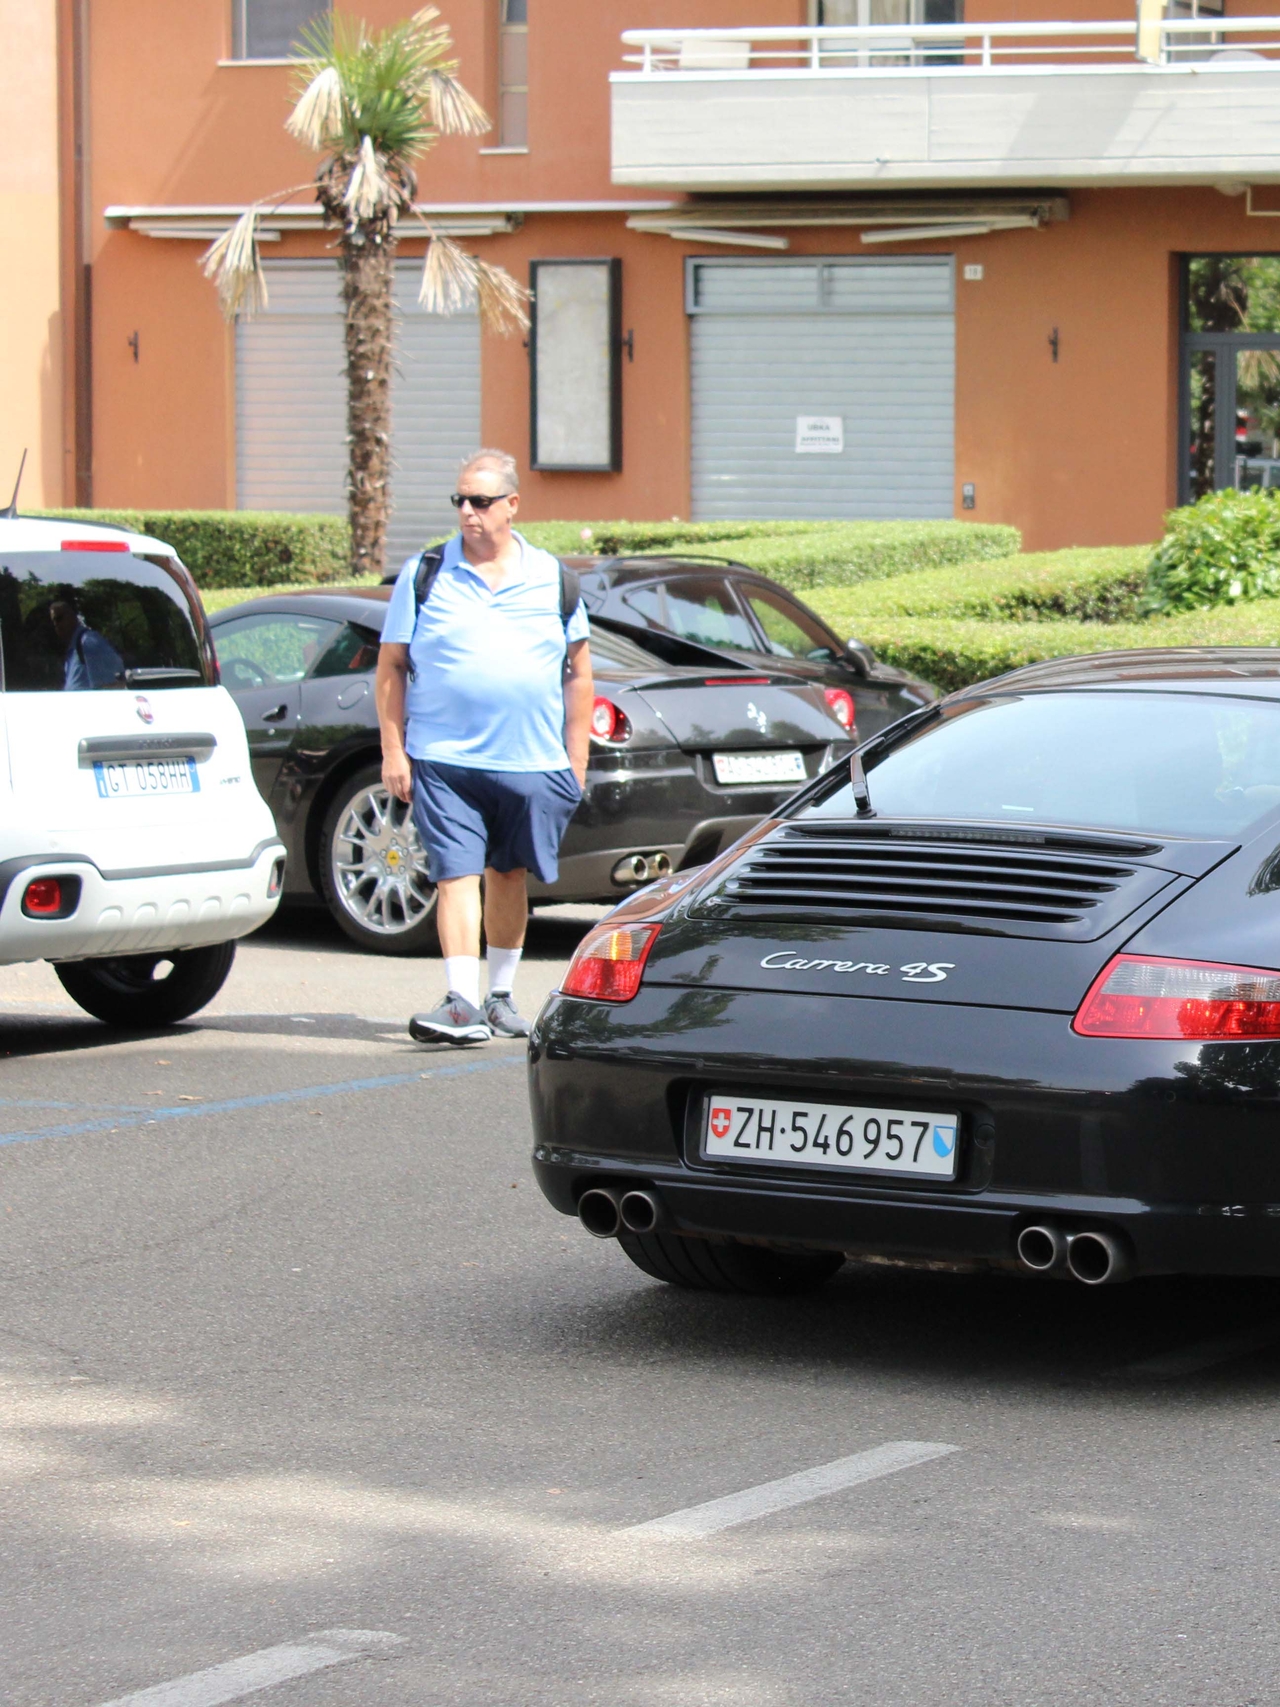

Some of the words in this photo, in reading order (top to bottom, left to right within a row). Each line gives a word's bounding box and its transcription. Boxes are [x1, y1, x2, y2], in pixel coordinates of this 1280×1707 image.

[107, 763, 130, 792] GT
[136, 759, 190, 791] 058HH
[760, 951, 891, 975] Carrera
[899, 962, 956, 983] 4S
